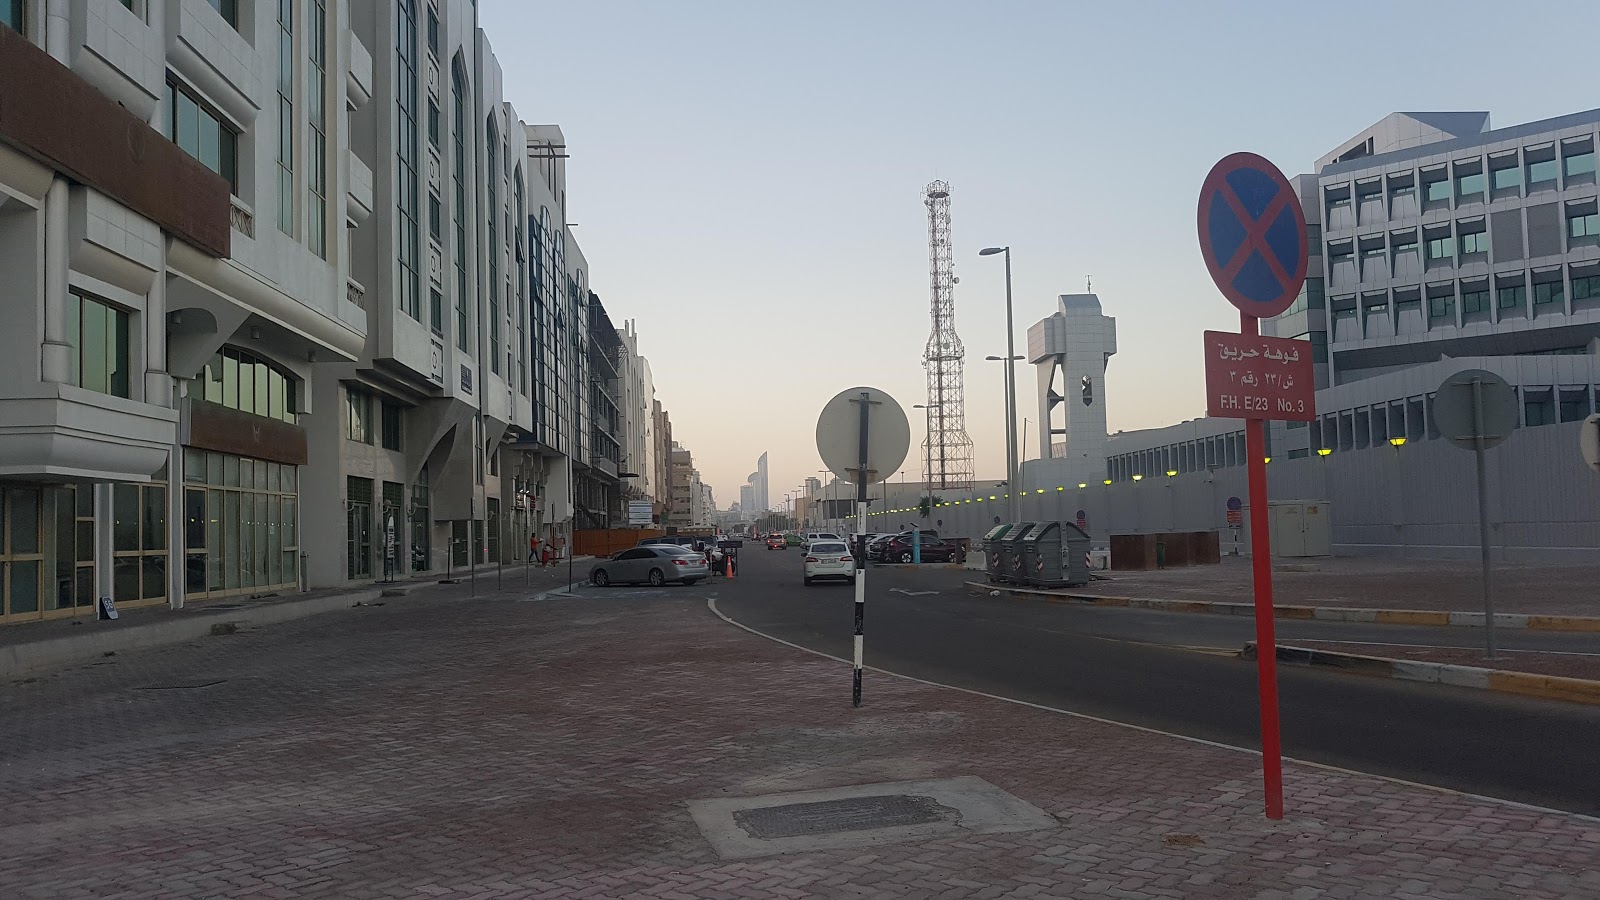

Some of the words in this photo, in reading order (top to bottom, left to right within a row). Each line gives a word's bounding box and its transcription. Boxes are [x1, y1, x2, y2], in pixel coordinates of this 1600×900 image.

[1218, 343, 1260, 361] حريق
[1263, 344, 1299, 364] فوهة
[1230, 370, 1236, 382] ٣
[1241, 370, 1258, 387] رقم
[1220, 394, 1241, 409] F.H.
[1244, 396, 1268, 411] E/23
[1278, 398, 1296, 412] No.
[1298, 400, 1304, 412] 3
